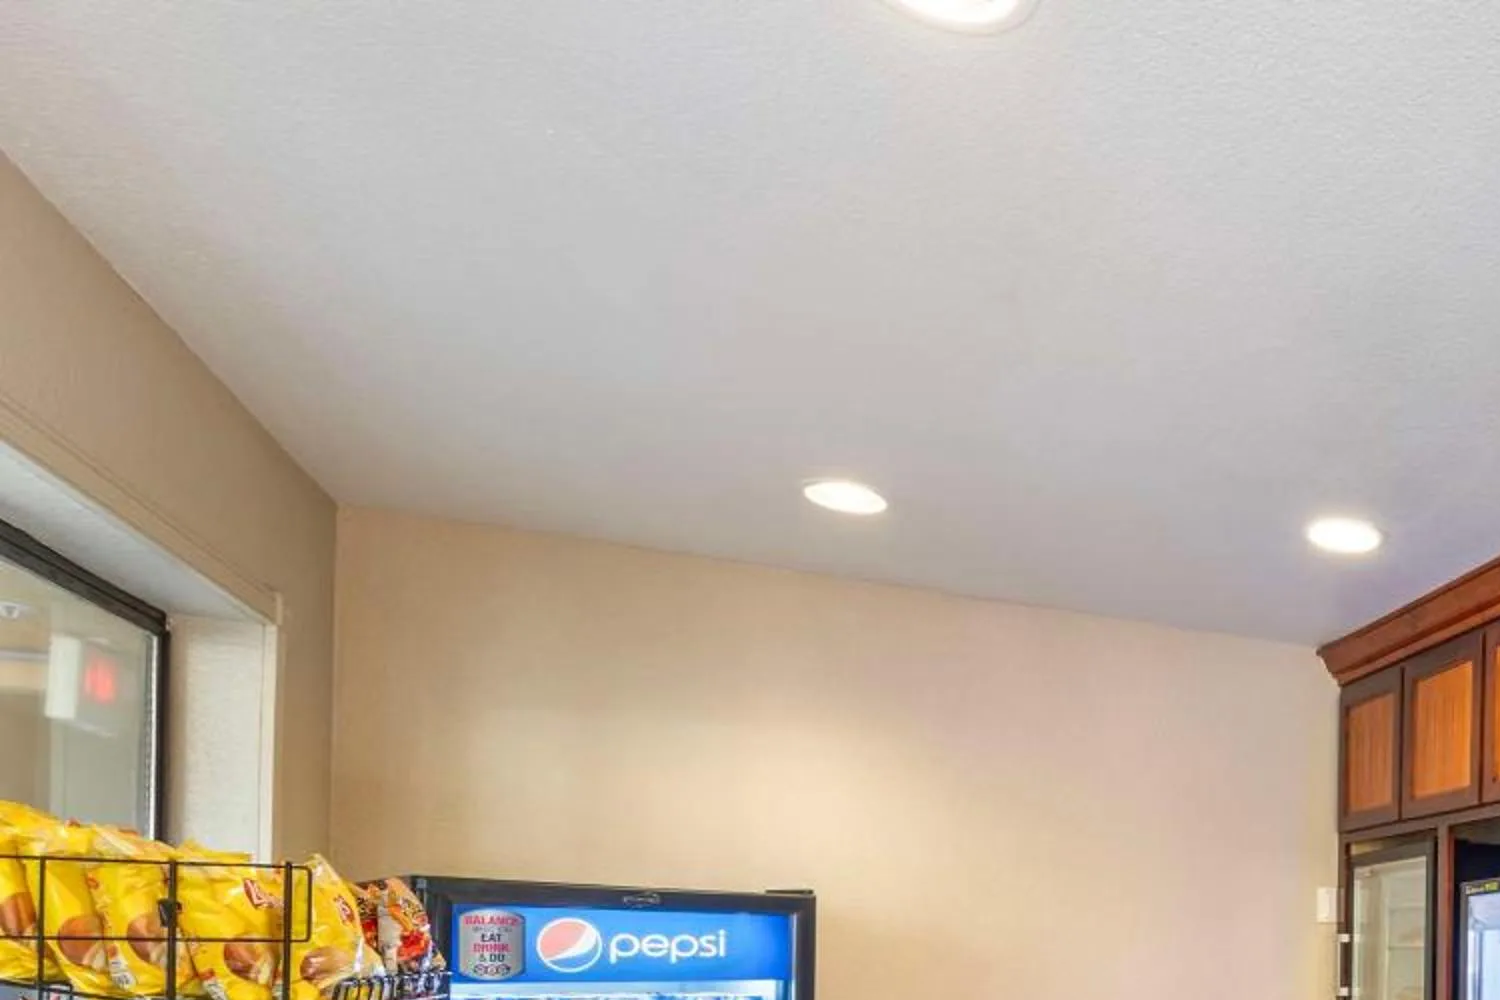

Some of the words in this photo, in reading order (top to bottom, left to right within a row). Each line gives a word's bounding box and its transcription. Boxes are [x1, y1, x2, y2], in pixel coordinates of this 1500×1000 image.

[464, 915, 519, 926] BALANCE
[481, 933, 502, 942] EAT
[609, 929, 727, 965] pepsi
